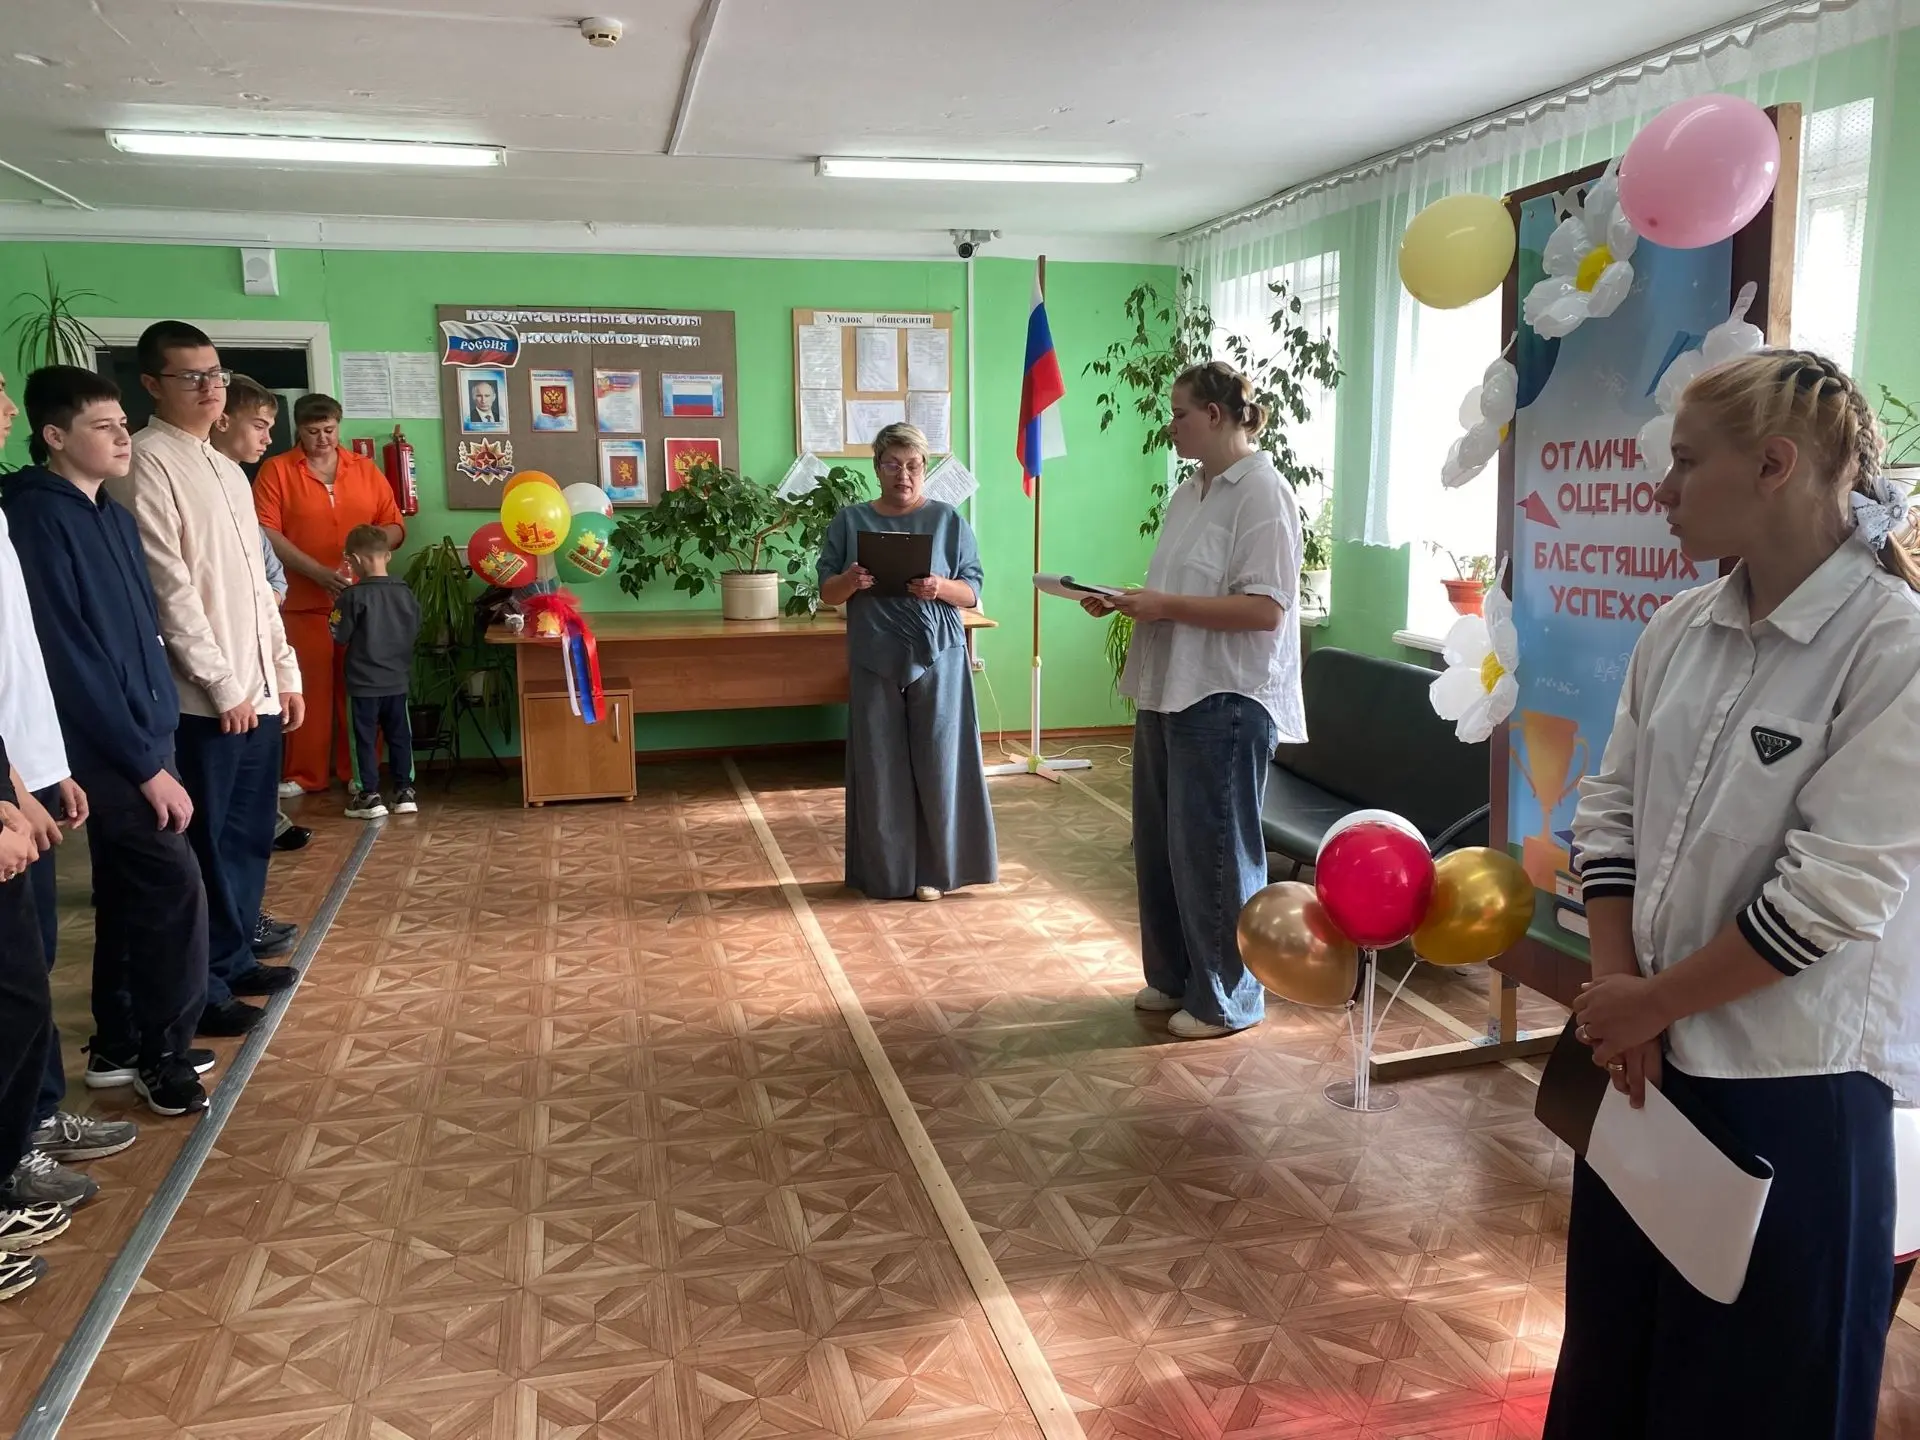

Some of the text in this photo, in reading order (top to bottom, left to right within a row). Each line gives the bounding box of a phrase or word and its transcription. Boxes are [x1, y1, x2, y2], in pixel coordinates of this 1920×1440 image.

[827, 314, 931, 325] Уголок общежития
[460, 340, 508, 352] РОССИЯ
[526, 331, 699, 348] РОССИЙСКОЙ ФЕДЕРАЦИИ
[1534, 542, 1700, 582] БЛЕСТЯЩИХ
